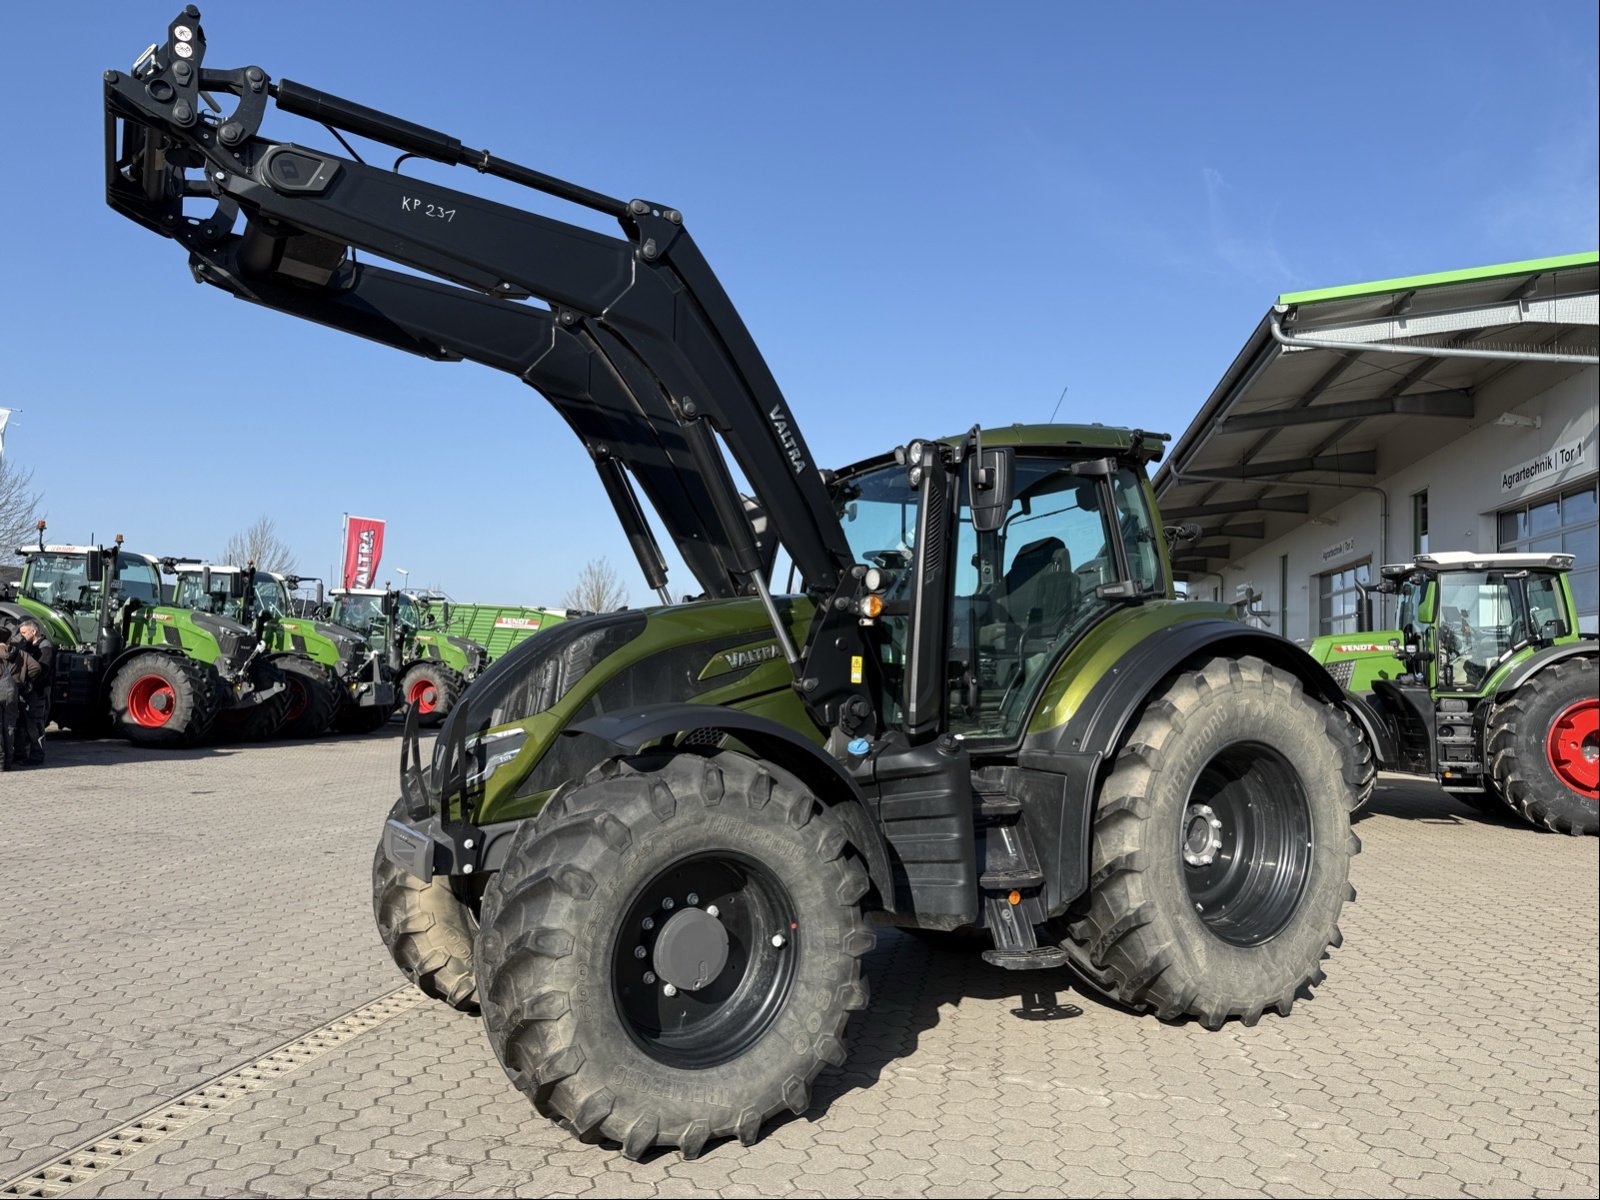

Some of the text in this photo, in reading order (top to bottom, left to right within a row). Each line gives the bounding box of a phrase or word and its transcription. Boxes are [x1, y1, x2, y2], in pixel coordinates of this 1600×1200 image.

[401, 195, 456, 223] KP 231
[770, 403, 806, 475] VALTRA
[1502, 456, 1553, 489] Agrartechnik
[1560, 447, 1575, 465] Tor
[1577, 441, 1582, 457] 1
[502, 617, 531, 625] FENDT
[1341, 643, 1374, 652] FENDT
